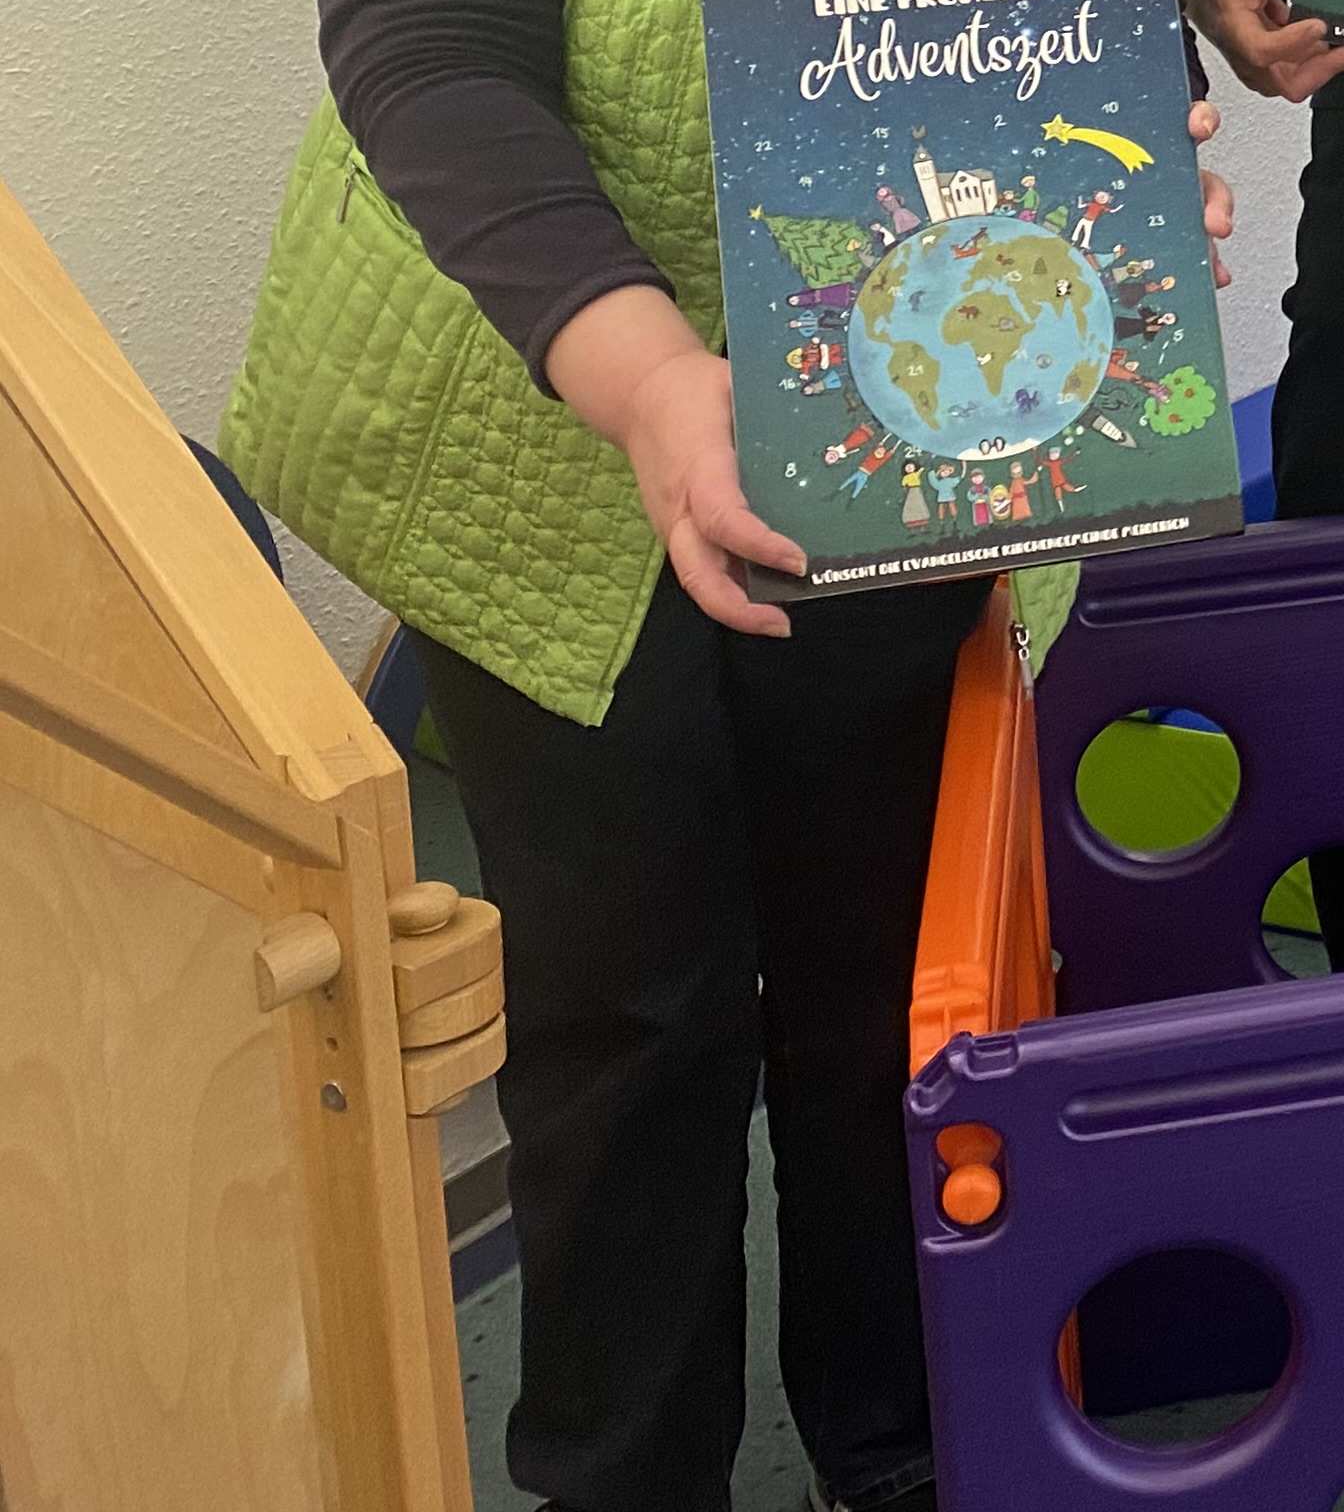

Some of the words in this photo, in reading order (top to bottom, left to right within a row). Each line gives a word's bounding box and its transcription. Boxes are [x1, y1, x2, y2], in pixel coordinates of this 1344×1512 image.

[1132, 24, 1144, 36] 3
[799, 0, 1103, 101] Adventszeit
[749, 64, 757, 75] 7
[1101, 101, 1119, 114] 10
[993, 113, 1008, 130] 2
[871, 127, 891, 139] 15
[754, 140, 773, 152] 22
[1148, 215, 1166, 227] 23
[768, 302, 777, 312] 1
[1173, 328, 1185, 342] 5
[1139, 415, 1148, 427] 6
[784, 462, 797, 478] 8
